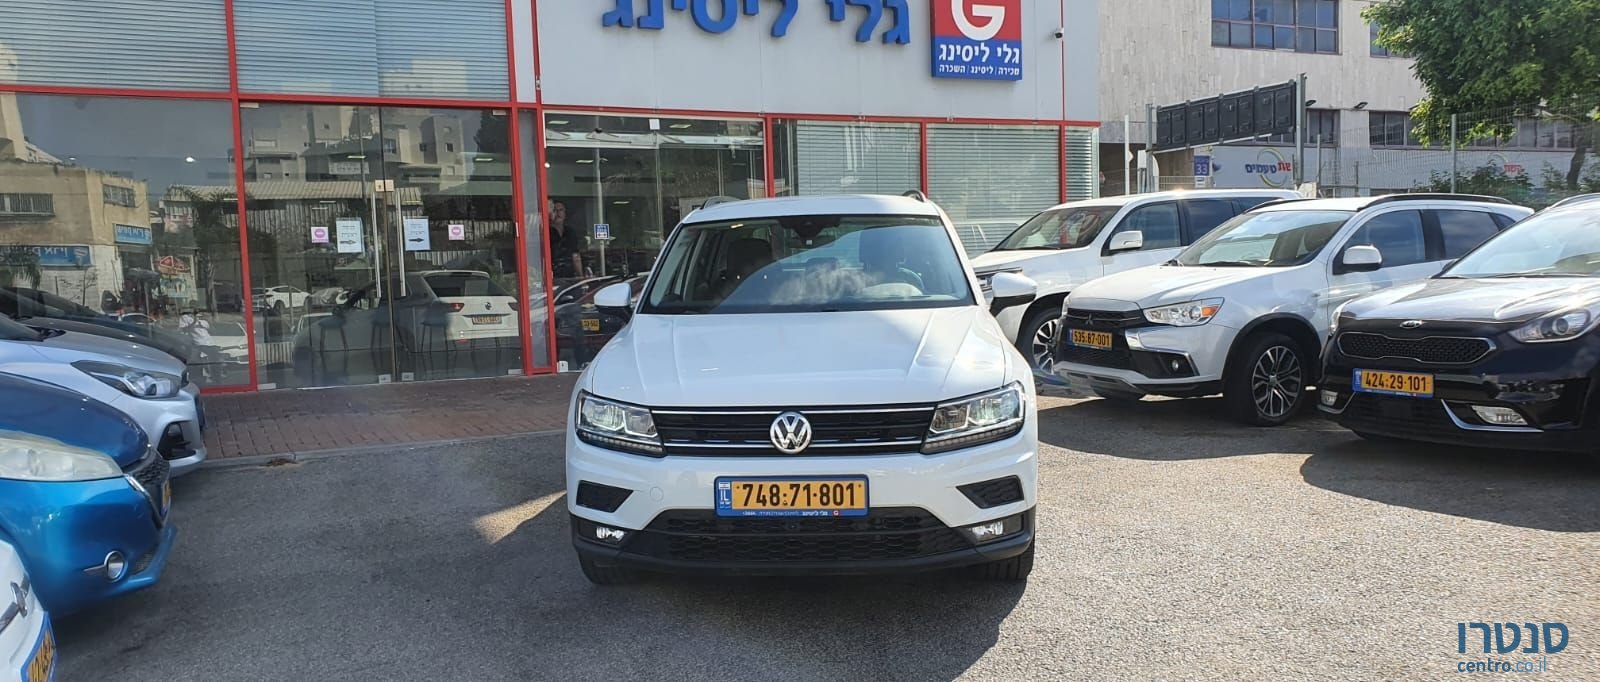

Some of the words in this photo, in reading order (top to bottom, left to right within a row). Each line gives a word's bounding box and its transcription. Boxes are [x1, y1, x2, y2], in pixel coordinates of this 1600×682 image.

[951, 0, 1006, 41] G
[938, 42, 990, 63] ליסינג
[997, 43, 1020, 64] גלי
[939, 64, 966, 73] השכרה
[970, 65, 994, 75] ליסינג
[998, 66, 1020, 76] מכירה
[1195, 163, 1208, 175] 33
[1245, 163, 1277, 174] טעמים
